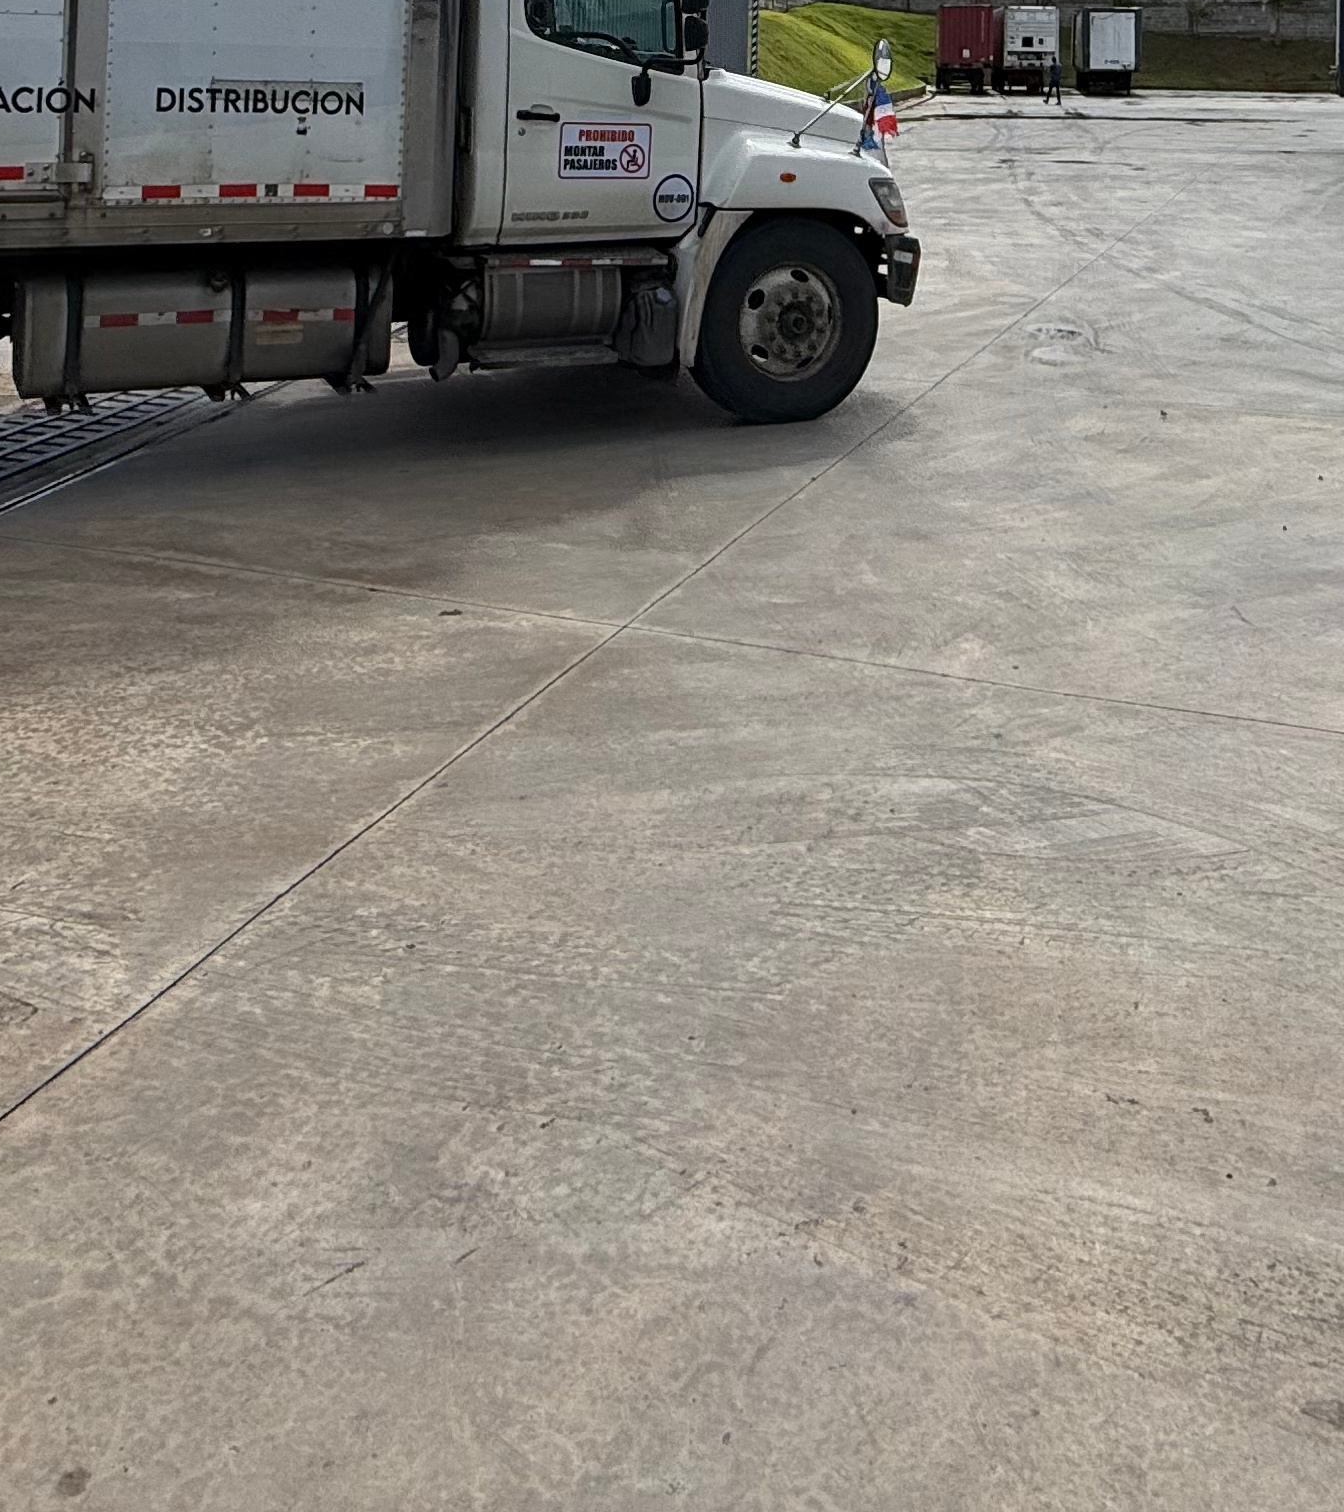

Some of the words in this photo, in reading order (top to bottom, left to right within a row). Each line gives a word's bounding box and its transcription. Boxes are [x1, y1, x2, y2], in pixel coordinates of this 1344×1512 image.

[156, 87, 365, 117] DISTRIBUCION
[578, 129, 635, 142] PROHIBIDO
[564, 145, 605, 157] MONTAR
[564, 158, 618, 171] PASAJEROS
